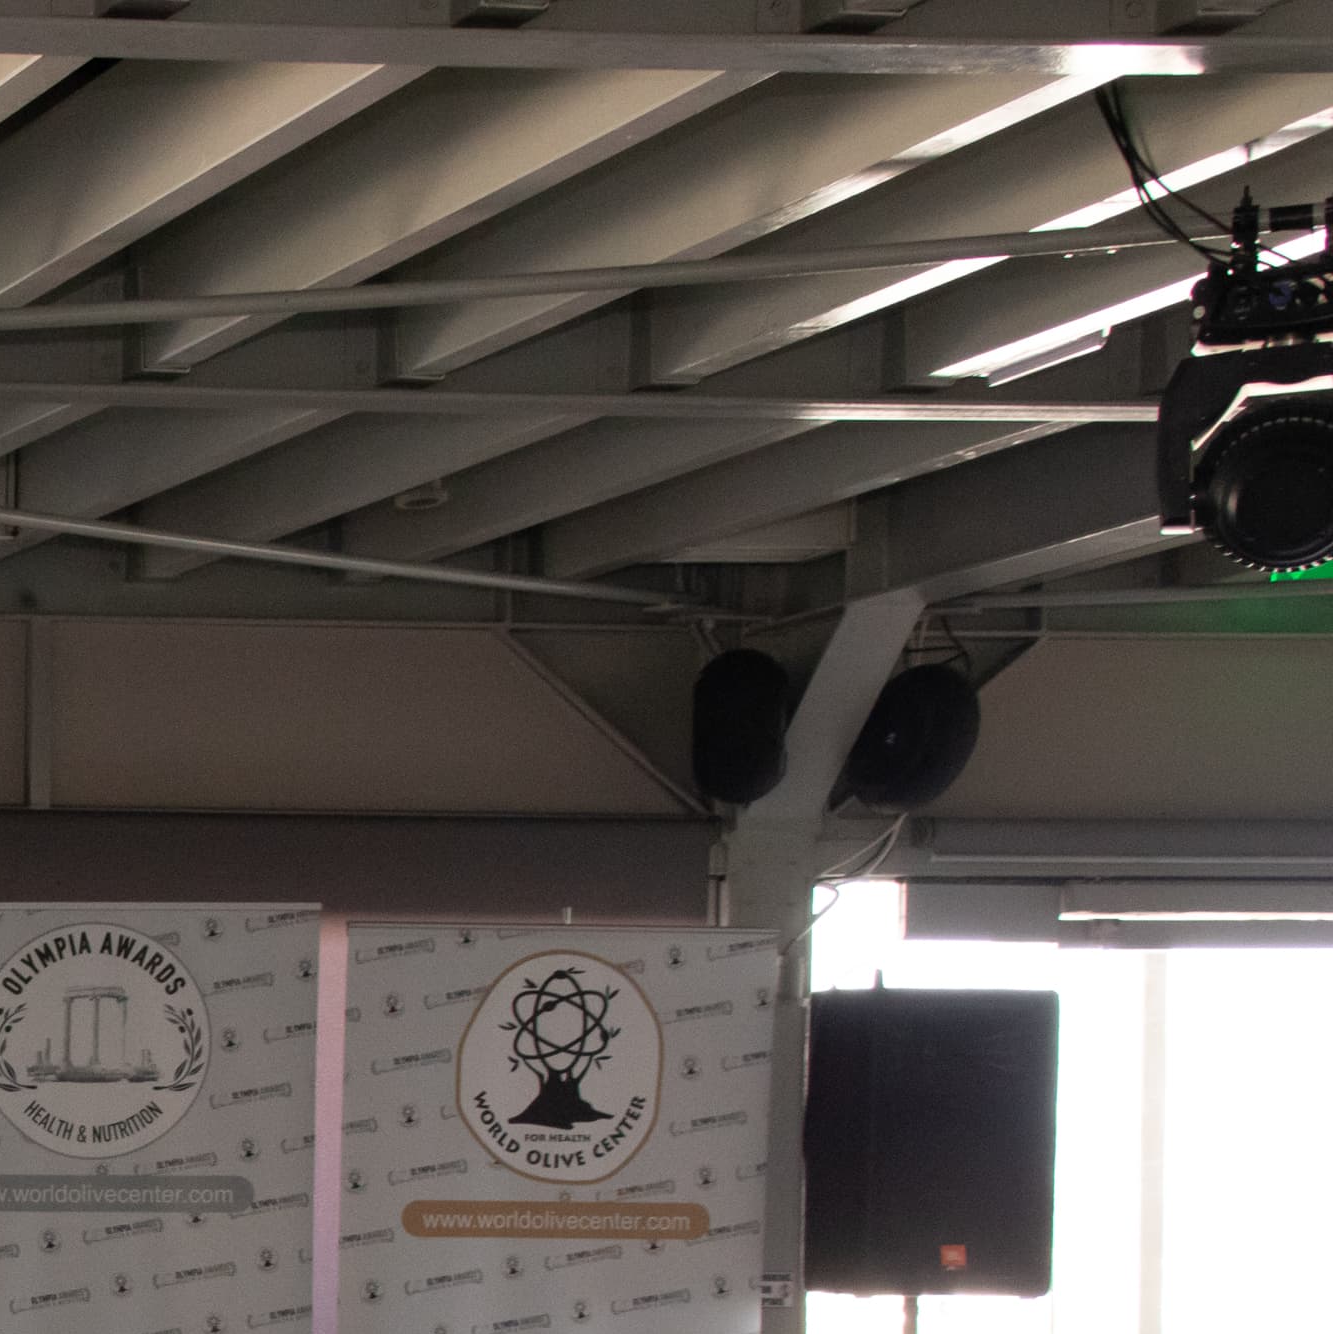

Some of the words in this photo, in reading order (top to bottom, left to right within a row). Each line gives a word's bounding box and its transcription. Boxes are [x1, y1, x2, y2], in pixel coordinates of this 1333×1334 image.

[1, 931, 92, 996] OLYMPIA
[100, 931, 186, 996] AWARDS
[23, 1100, 75, 1141] HEALTH
[76, 1124, 87, 1143] &
[92, 1100, 164, 1143] NUTRITION
[473, 1090, 521, 1154] WORLD
[526, 1150, 587, 1169] OLIVE
[592, 1095, 646, 1159] CENTER
[422, 1209, 691, 1232] www.worldolivecenter.com
